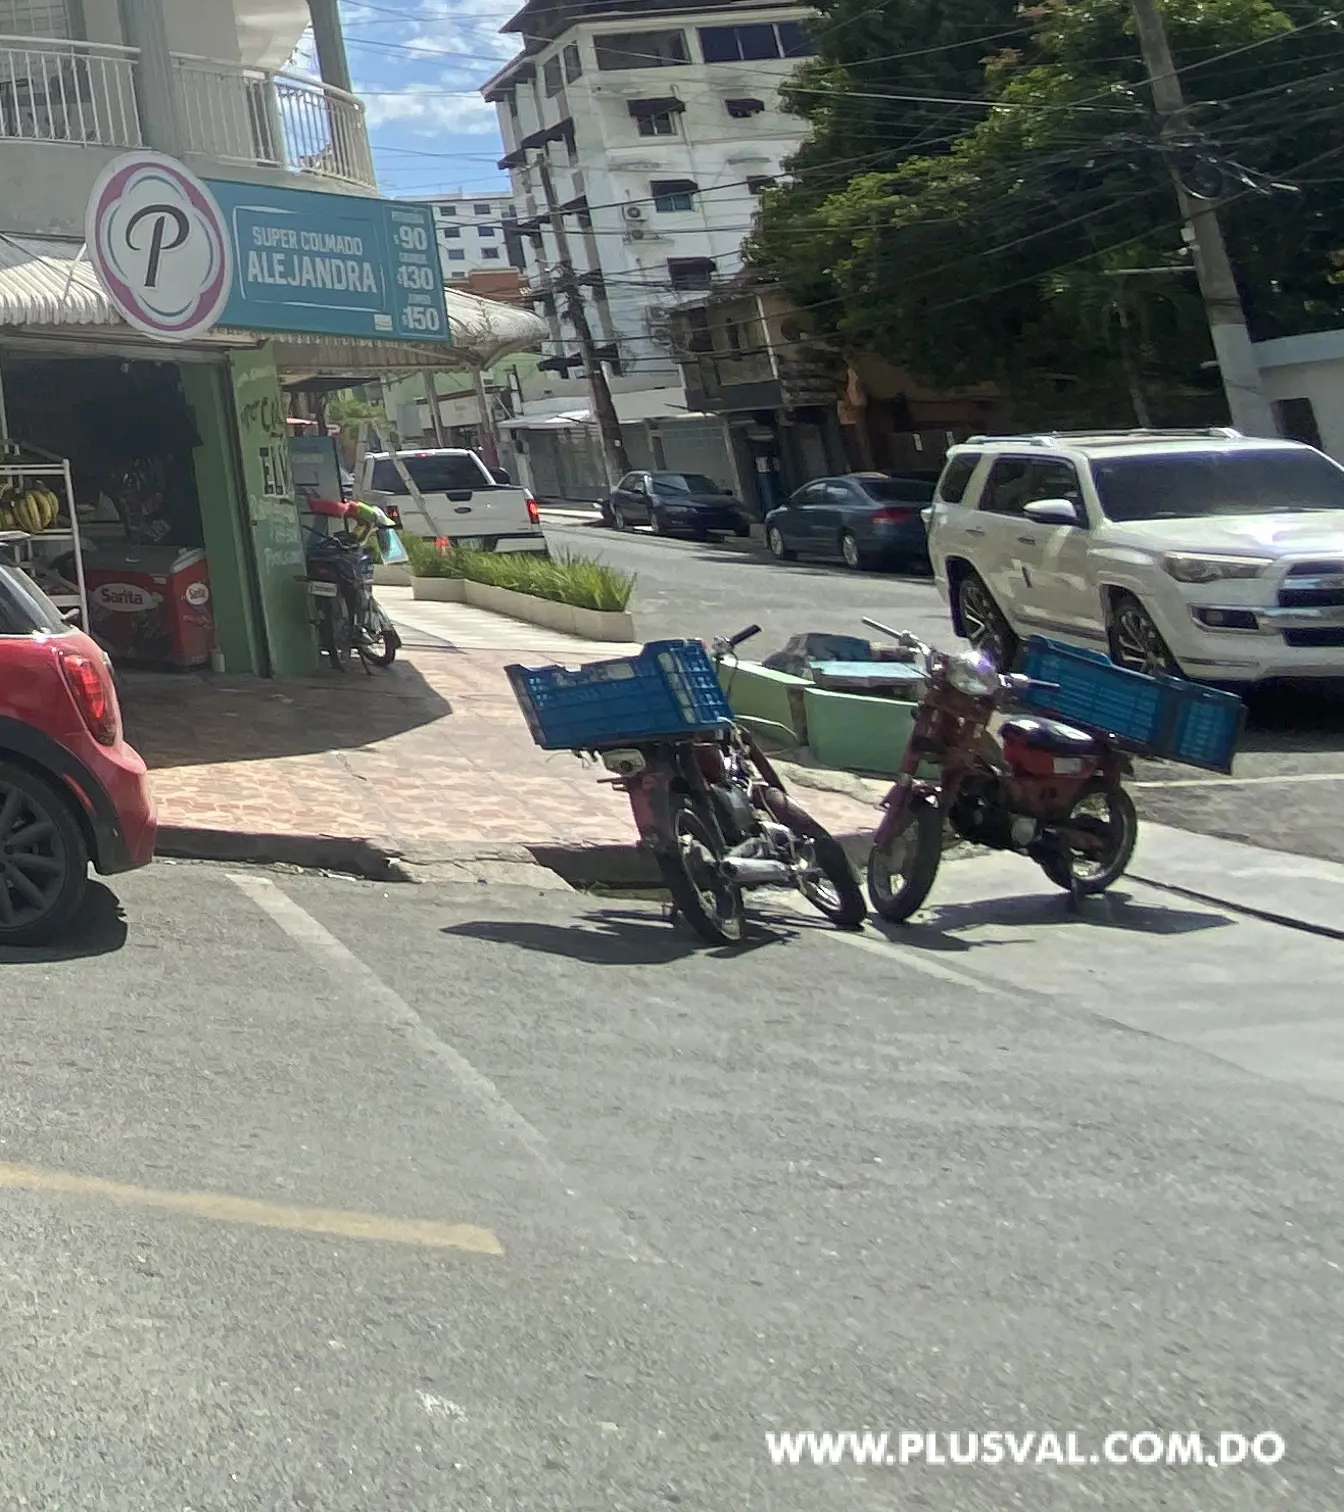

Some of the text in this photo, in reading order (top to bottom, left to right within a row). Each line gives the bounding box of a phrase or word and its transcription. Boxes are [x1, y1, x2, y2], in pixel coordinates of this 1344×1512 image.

[125, 204, 190, 288] P
[252, 226, 363, 256] SUPER COLMADO
[248, 250, 378, 293] ALEJANDRA
[102, 589, 144, 605] Sarita
